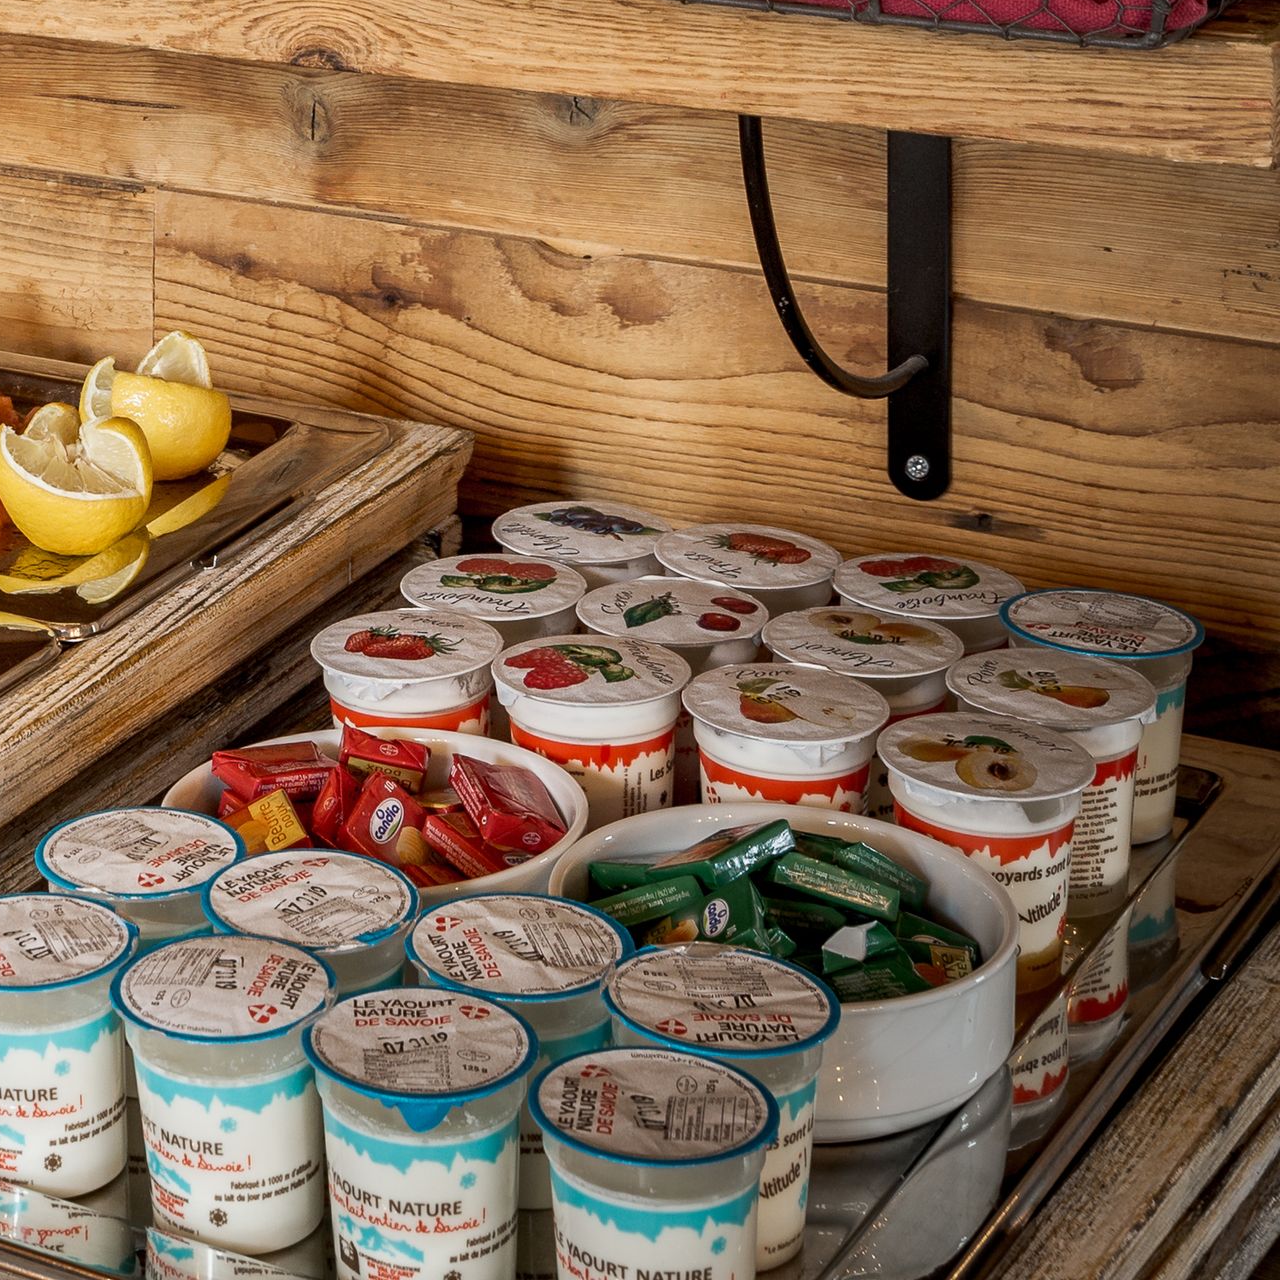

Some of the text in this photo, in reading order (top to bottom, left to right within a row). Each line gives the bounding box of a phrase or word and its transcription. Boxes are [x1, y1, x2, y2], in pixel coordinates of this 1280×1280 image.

[895, 590, 1008, 611] Framboise
[650, 766, 664, 782] Les
[259, 801, 287, 845] Beurre
[374, 804, 401, 840] candia
[146, 846, 188, 868] SAVOIE
[172, 853, 222, 882] YAOURT
[216, 860, 296, 892] LE YAOURT
[226, 870, 287, 898] NATURE
[991, 859, 1066, 886] oyards sont
[238, 870, 313, 904] DE SAVOIE
[427, 934, 458, 974] YAOURT
[452, 940, 485, 980] NATURE
[463, 927, 502, 978] DE SAVOIE
[247, 954, 284, 997] DE SAVOIE
[270, 958, 302, 991] NATURE
[280, 972, 311, 1010] YAOURT
[353, 998, 456, 1009] LE YAOURT
[353, 1009, 428, 1018] NATURE
[355, 1015, 452, 1027] DE SAVOIE
[692, 1013, 793, 1023] DE SAVOIE
[695, 1032, 800, 1043] LE YAOURT
[719, 1022, 796, 1033] NATURE
[16, 1105, 29, 1118] de
[576, 1088, 598, 1132] NATURE
[596, 1082, 619, 1135] DE SAVOIE
[161, 1129, 224, 1155] NATURE
[783, 1126, 806, 1148] sont
[182, 1155, 194, 1168] de
[268, 1174, 283, 1186] 1000
[247, 1192, 260, 1203] jour
[262, 1190, 273, 1201] par
[388, 1199, 462, 1217] NATURE
[369, 1213, 411, 1232] entier
[415, 1220, 430, 1234] de
[567, 1238, 712, 1280] YAOURT NATURE
